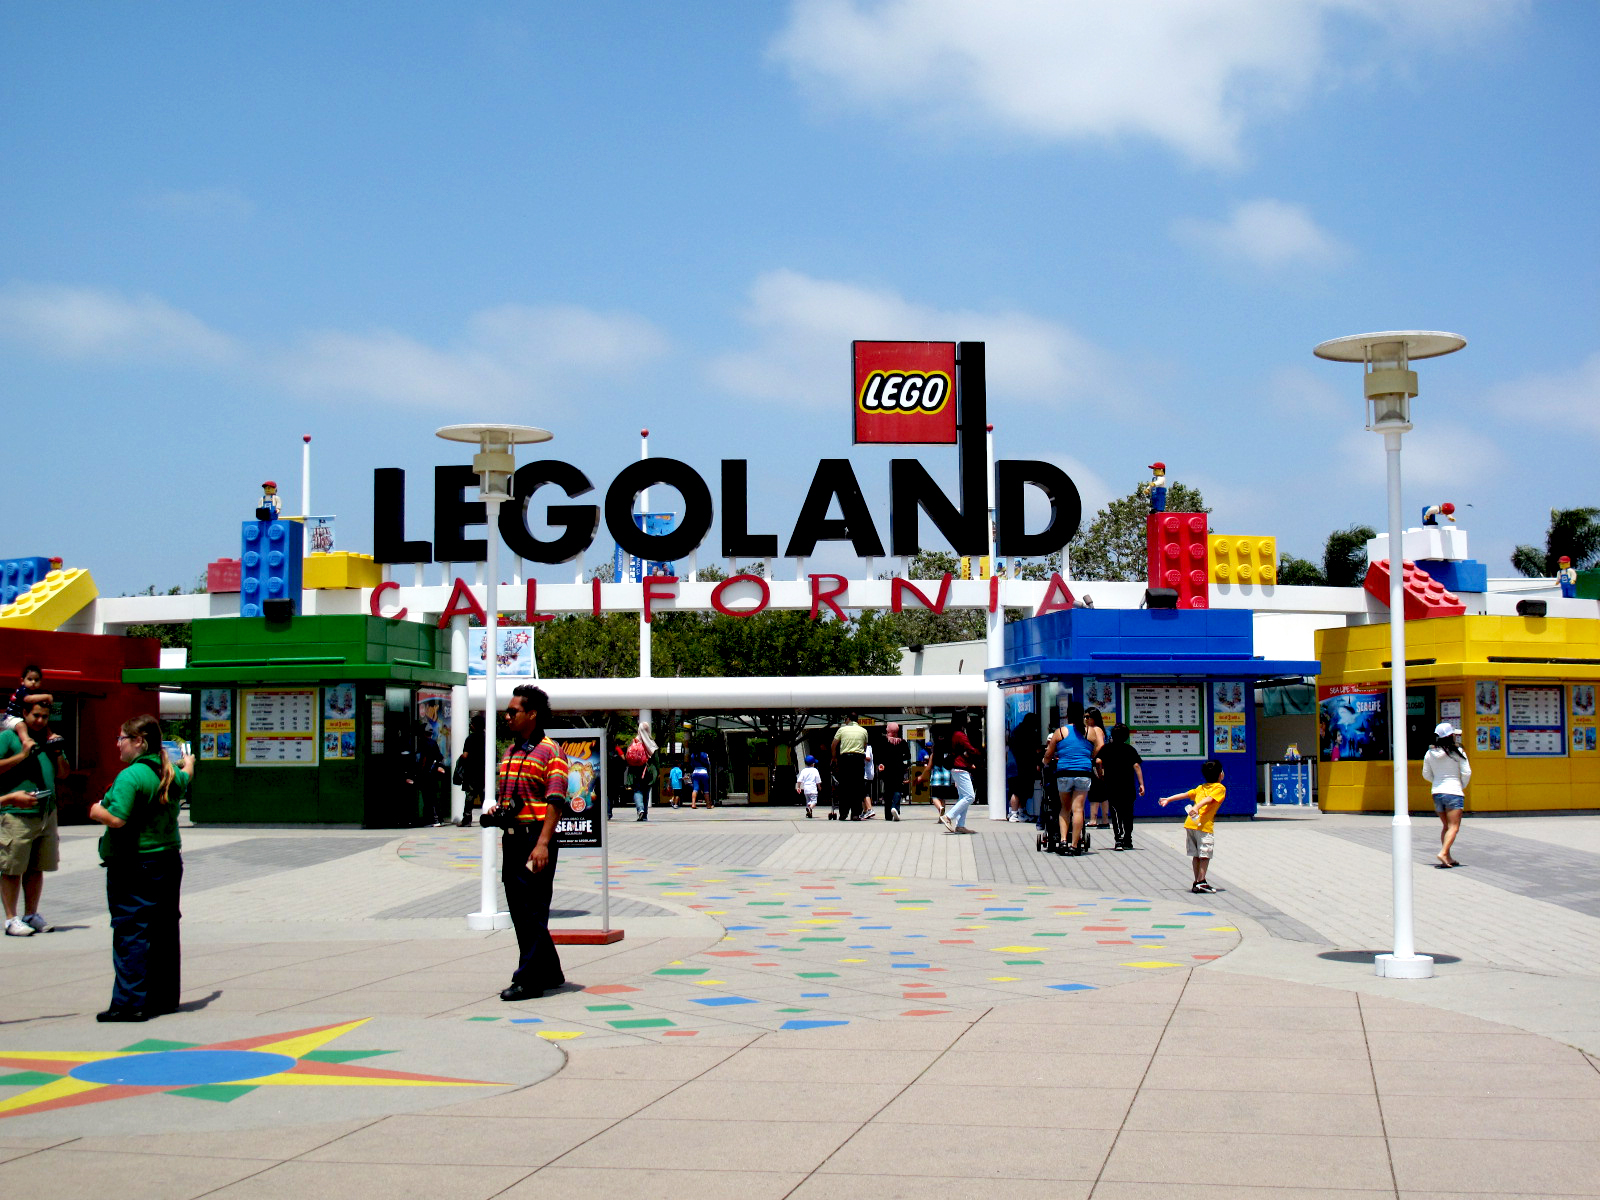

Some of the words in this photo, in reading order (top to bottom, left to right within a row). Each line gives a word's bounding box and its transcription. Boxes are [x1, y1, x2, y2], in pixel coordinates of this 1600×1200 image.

[864, 375, 945, 409] LEGO
[373, 457, 1082, 565] LEGOLAND
[370, 572, 1076, 630] CALIFORNIA
[1356, 701, 1369, 713] SEA
[554, 820, 574, 833] SEA
